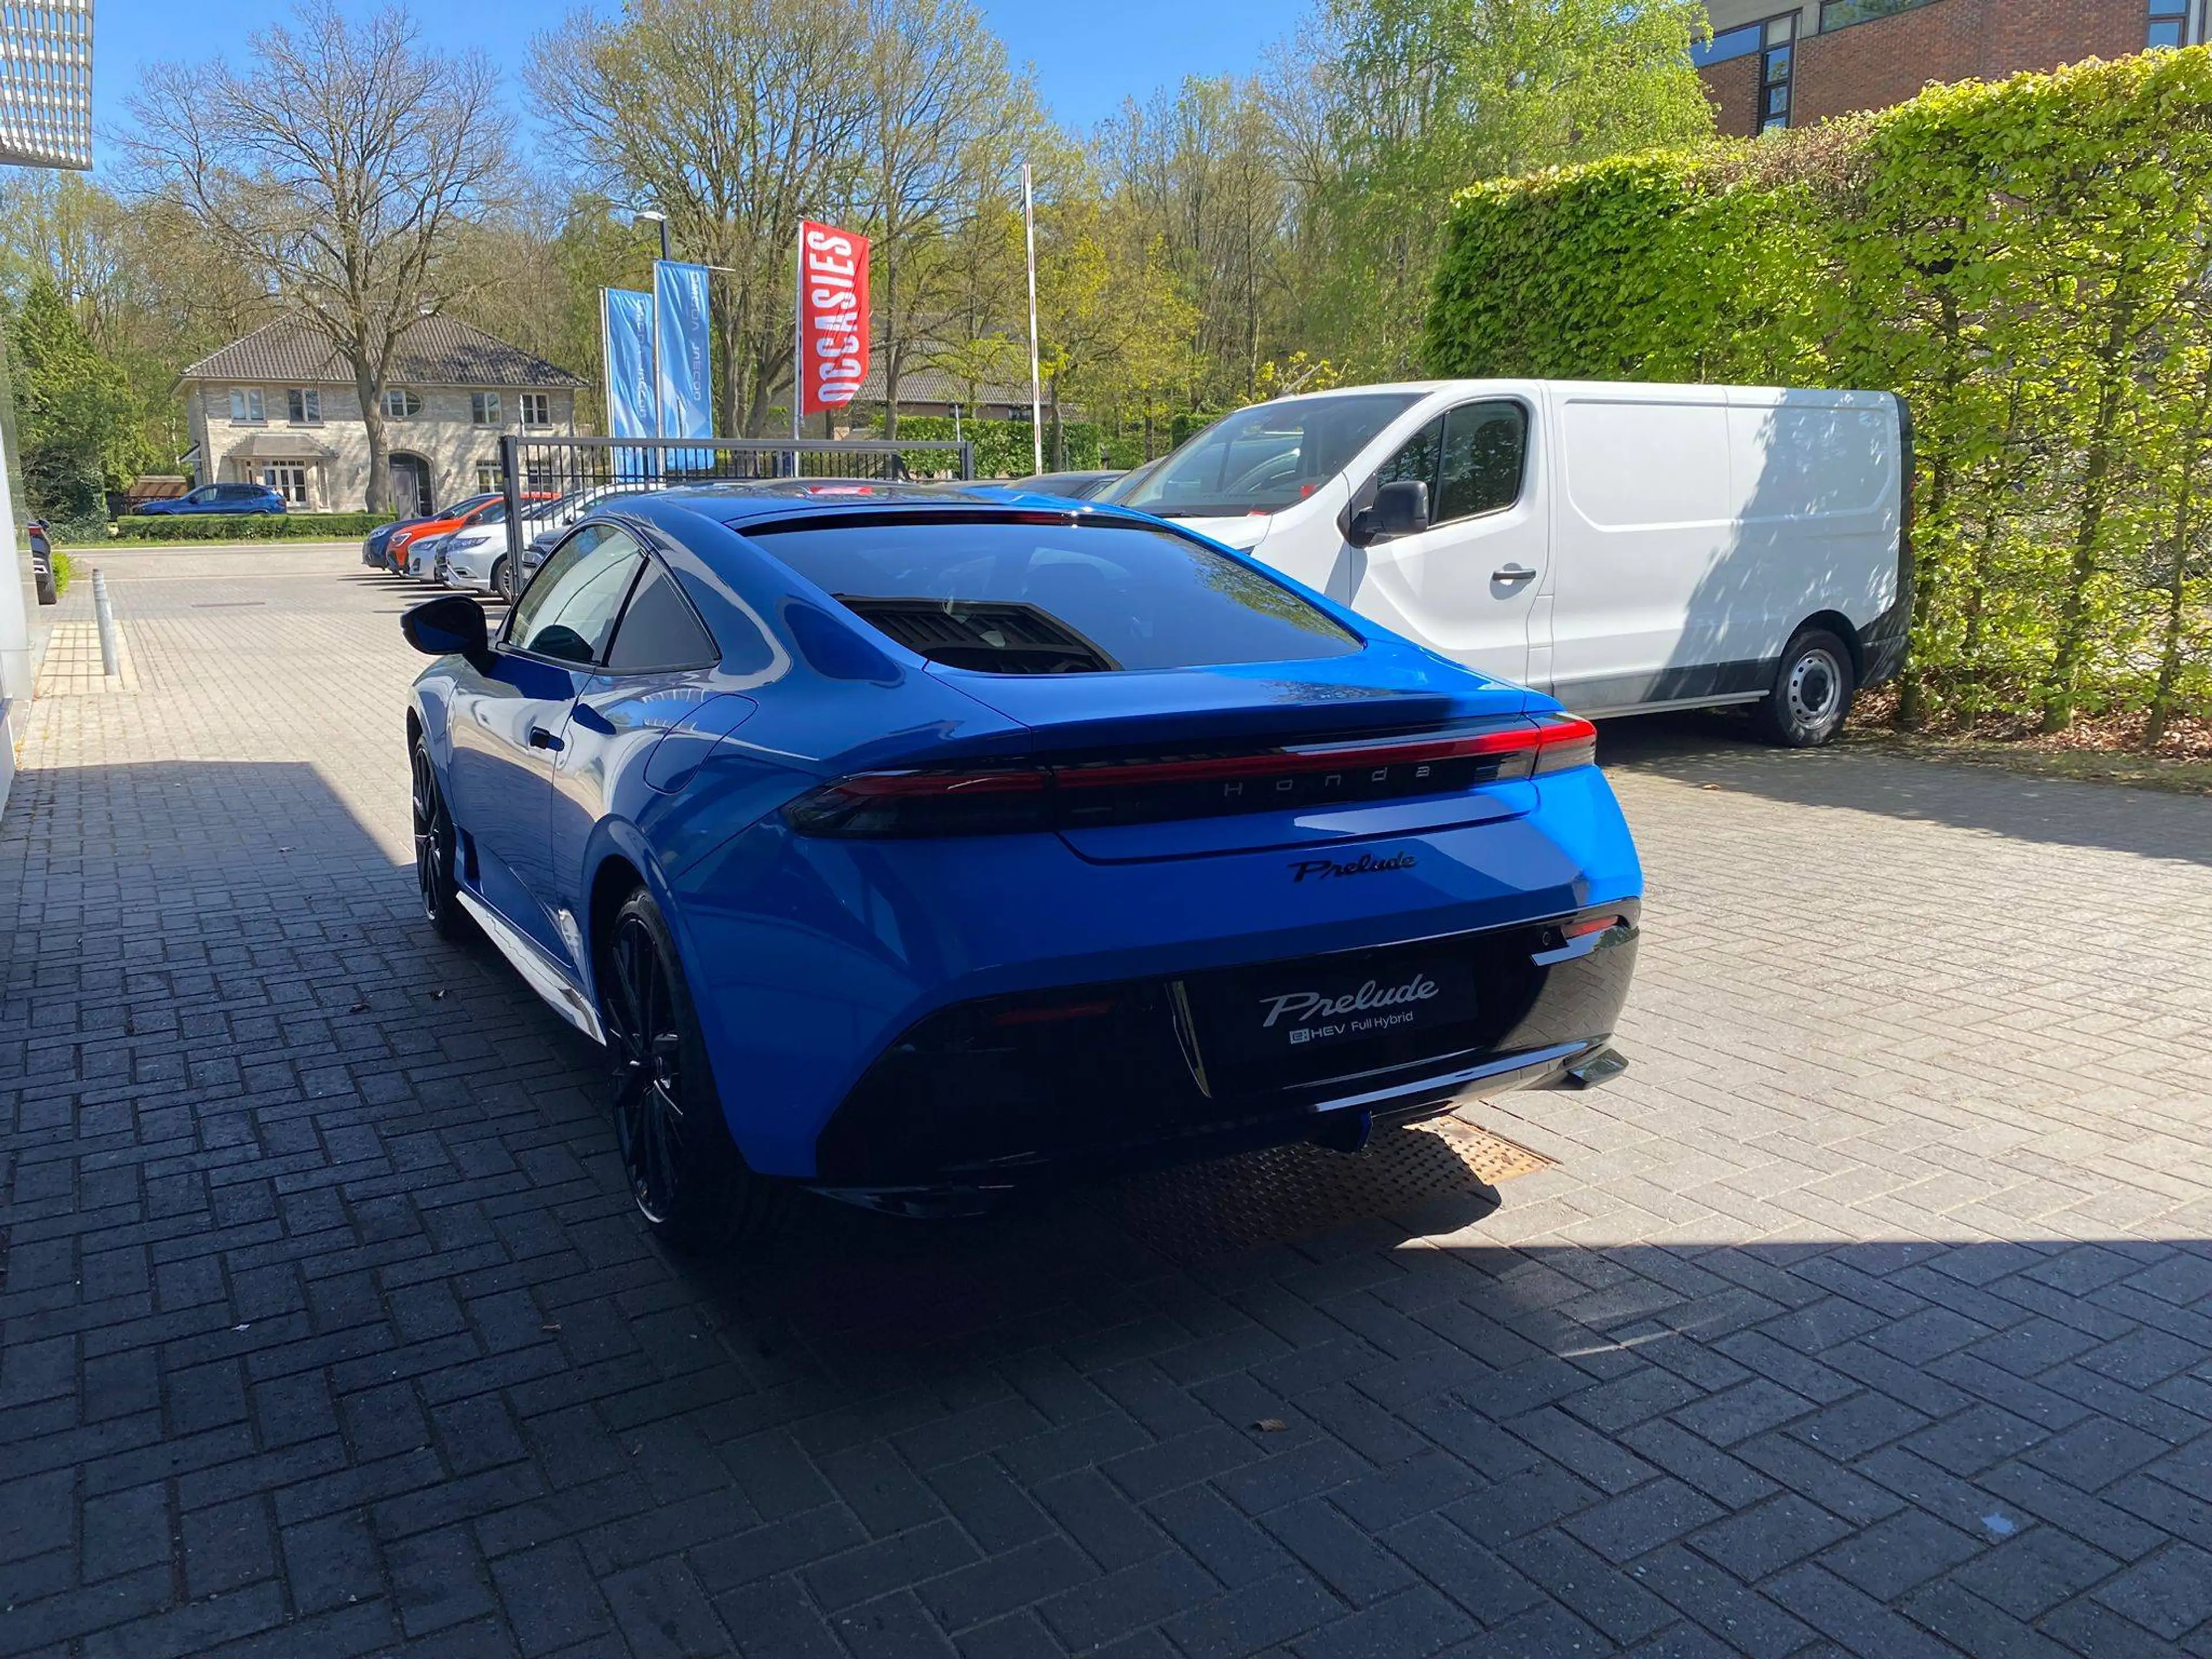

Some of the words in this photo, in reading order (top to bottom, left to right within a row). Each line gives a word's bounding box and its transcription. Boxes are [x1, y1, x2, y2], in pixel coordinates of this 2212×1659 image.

[807, 230, 861, 402] OCCASIES
[691, 340, 701, 401] JAECOO
[1287, 851, 1418, 883] Prelude
[1259, 974, 1439, 1028] Prelude
[1351, 1020, 1372, 1032] Full
[1374, 1011, 1414, 1029] Hybrid
